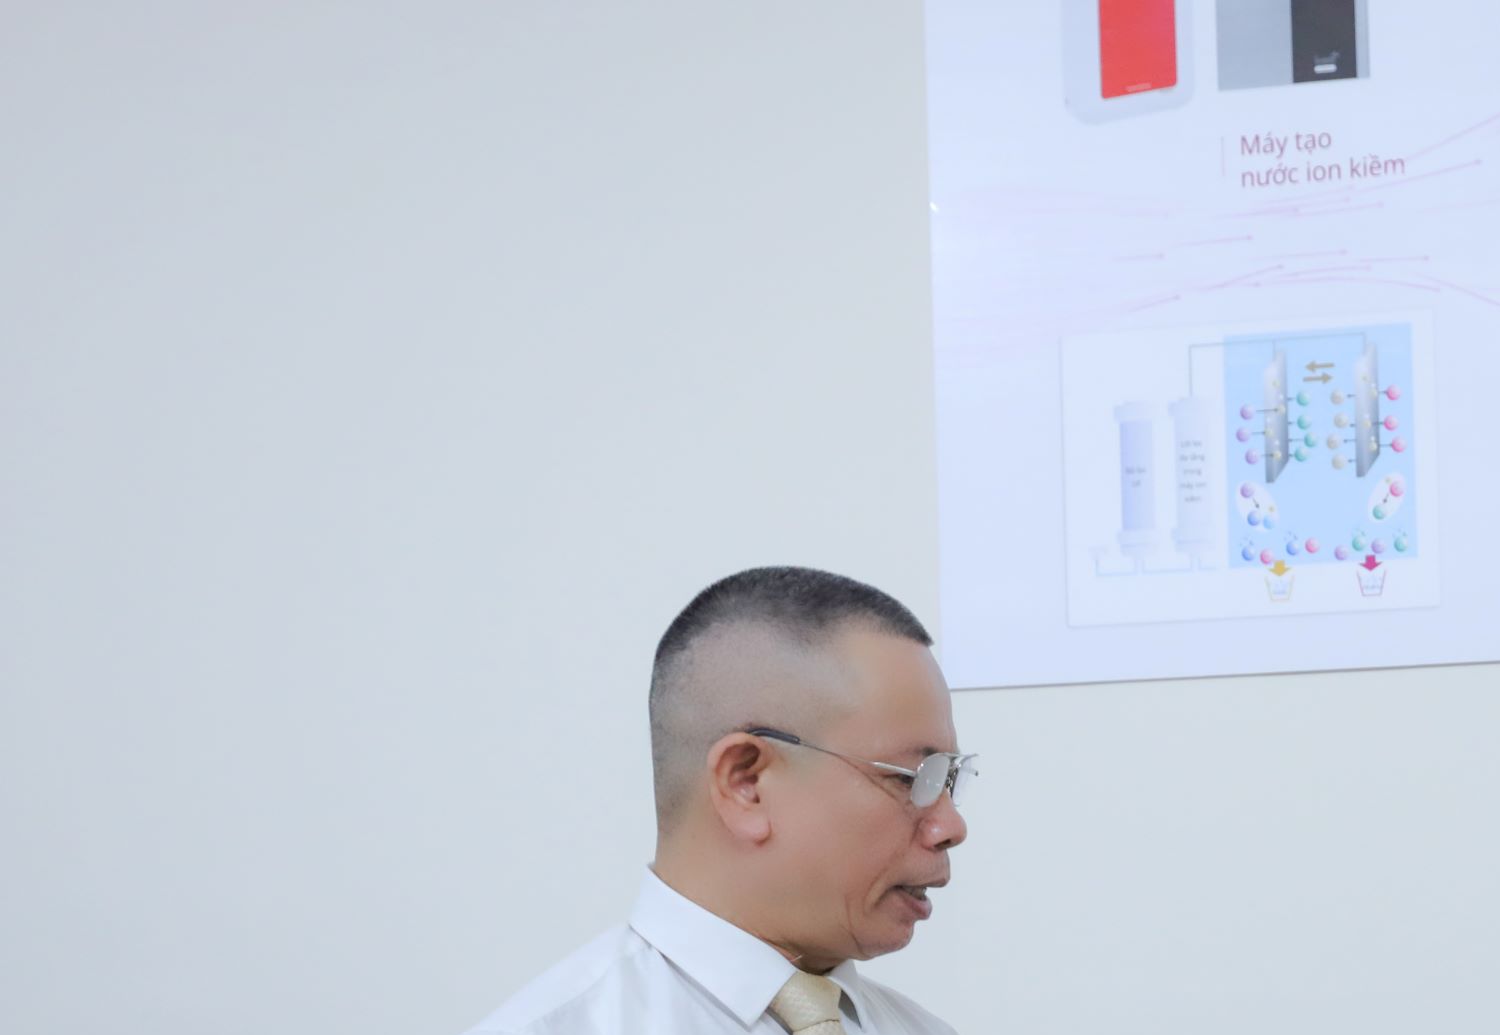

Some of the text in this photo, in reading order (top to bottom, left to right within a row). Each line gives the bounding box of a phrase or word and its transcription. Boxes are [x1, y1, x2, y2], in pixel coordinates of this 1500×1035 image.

[1240, 131, 1332, 160] Máy tạo
[1241, 153, 1406, 188] nước ion kiềm
